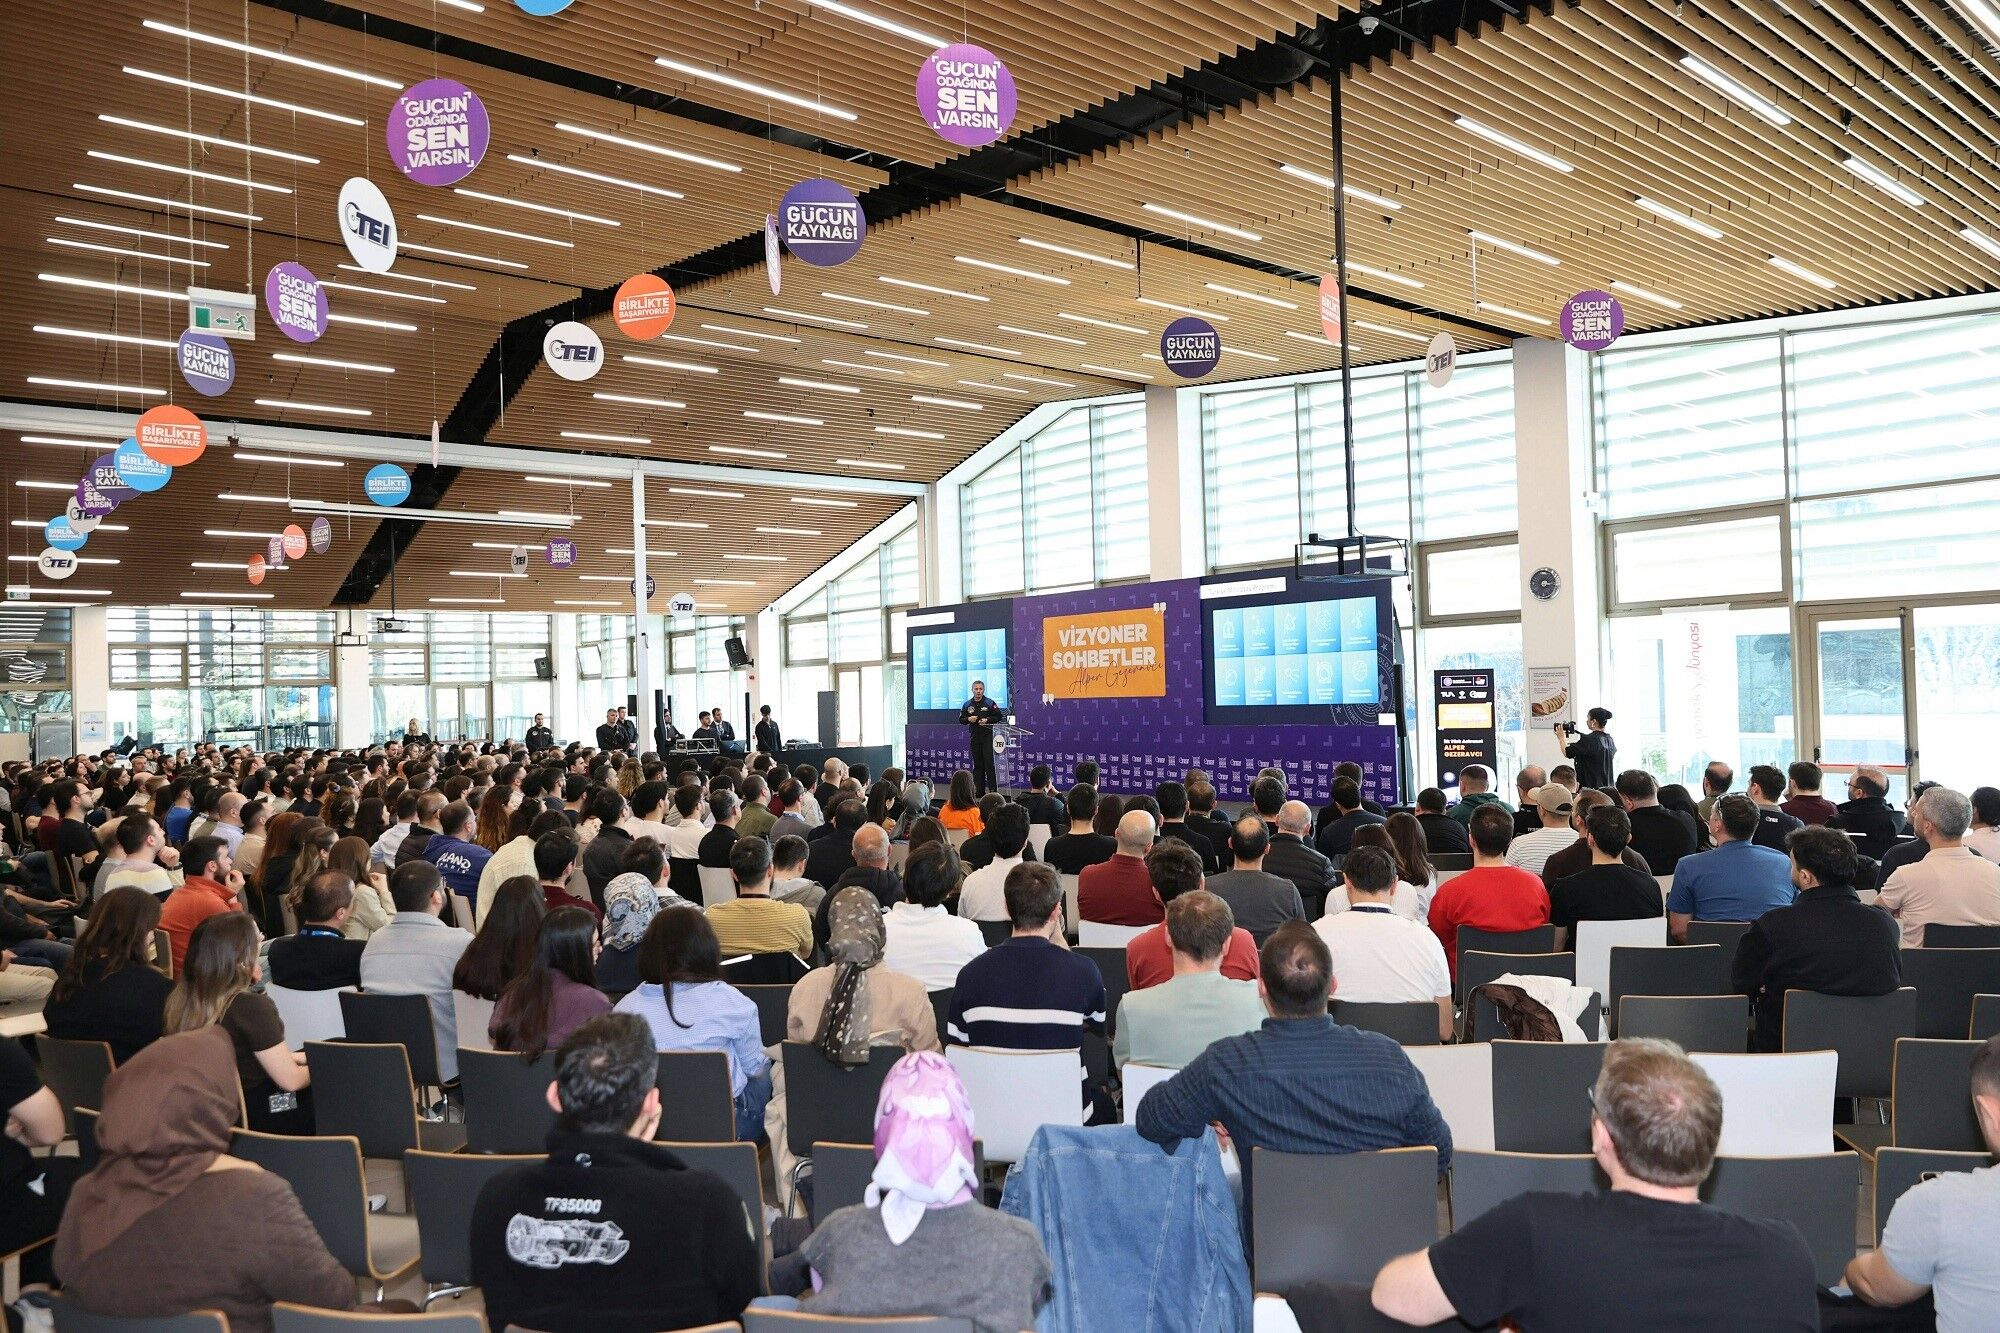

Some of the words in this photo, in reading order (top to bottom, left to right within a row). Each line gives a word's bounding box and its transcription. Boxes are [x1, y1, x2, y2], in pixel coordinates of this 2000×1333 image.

[937, 88, 998, 113] SEN
[937, 110, 998, 129] VARSIN
[407, 125, 469, 152] SEN
[407, 148, 470, 168] VARSIN
[787, 206, 857, 226] GÜCÜN
[356, 212, 392, 249] TEI
[279, 294, 317, 321] SEN
[619, 298, 669, 311] BİRLİKTE
[619, 308, 669, 319] BAŞARIYORUZ
[279, 310, 317, 333] VARSIN
[1572, 317, 1611, 331] SEN
[1572, 331, 1611, 340] VARSIN
[561, 345, 597, 362] TEI
[1434, 350, 1453, 372] TEI
[142, 424, 201, 440] BİRLİKTE
[142, 436, 200, 447] BAŞARIYORUZ
[1058, 624, 1147, 647] VİZYONER
[1052, 647, 1156, 669] SOHBETLER
[545, 1197, 602, 1214] TF35000
